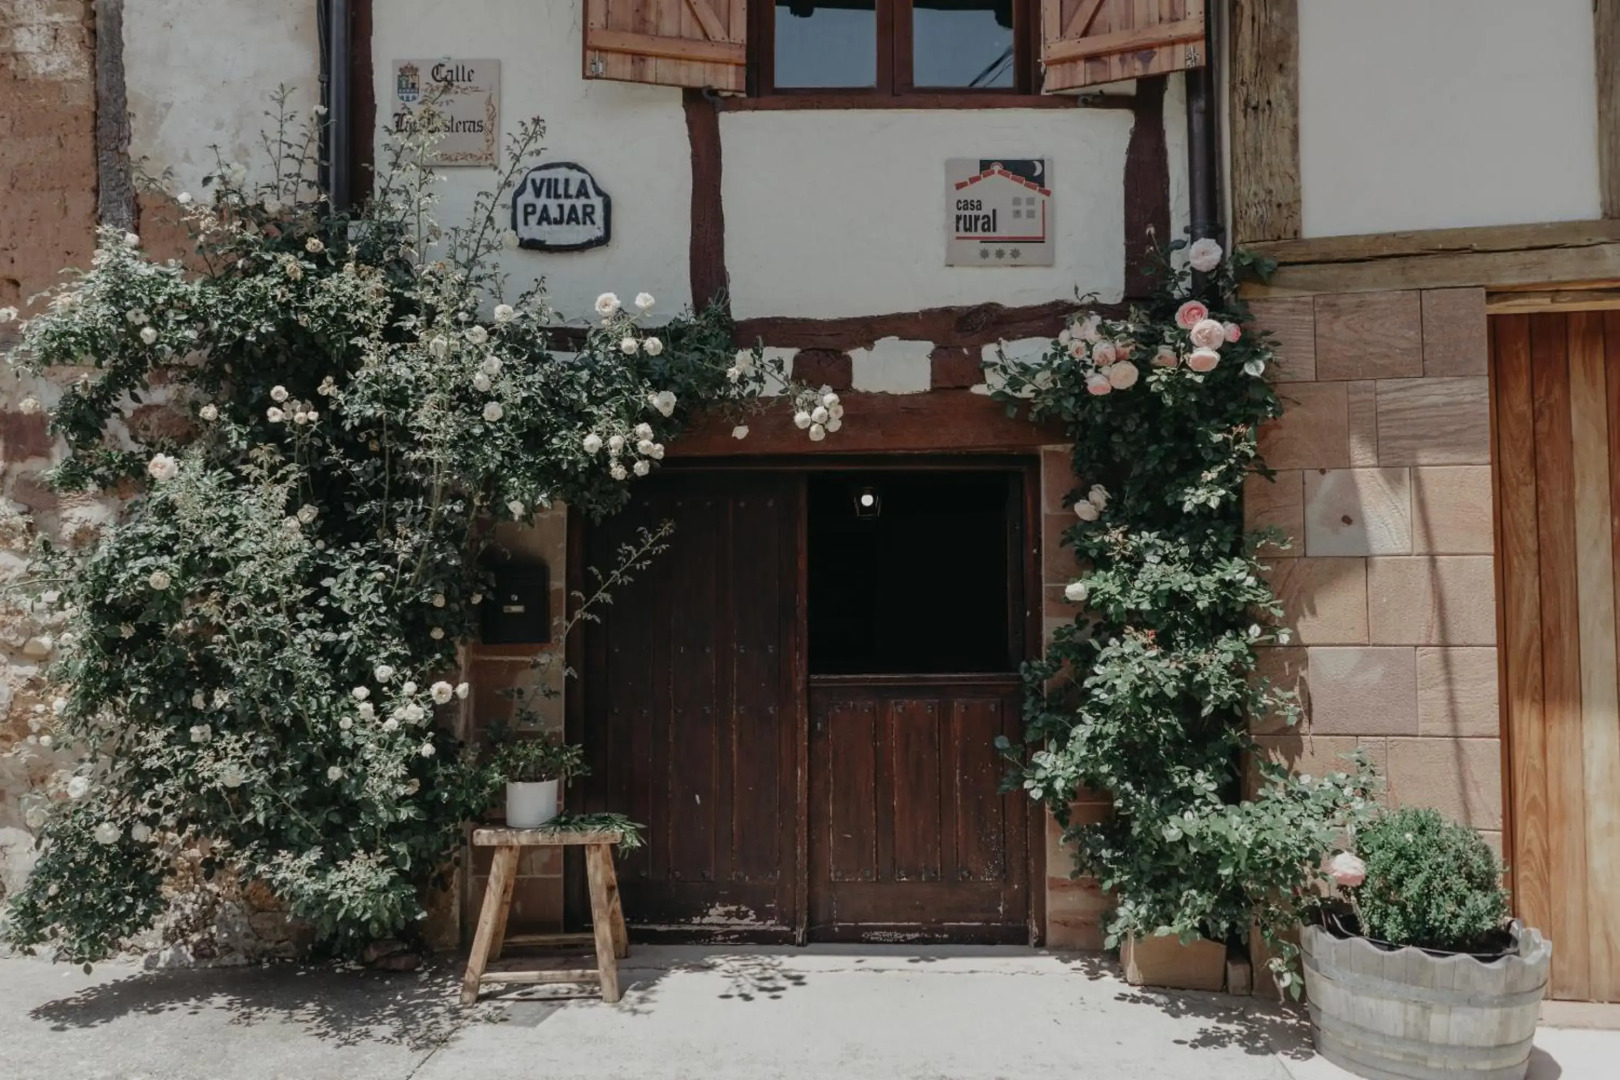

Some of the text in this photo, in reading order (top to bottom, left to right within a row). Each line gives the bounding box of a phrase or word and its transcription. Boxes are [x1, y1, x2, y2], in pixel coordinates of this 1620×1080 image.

[431, 63, 475, 83] Calle
[530, 178, 591, 199] VILLA
[523, 203, 596, 226] PAJAR
[956, 199, 982, 211] casa
[955, 208, 997, 233] rural
